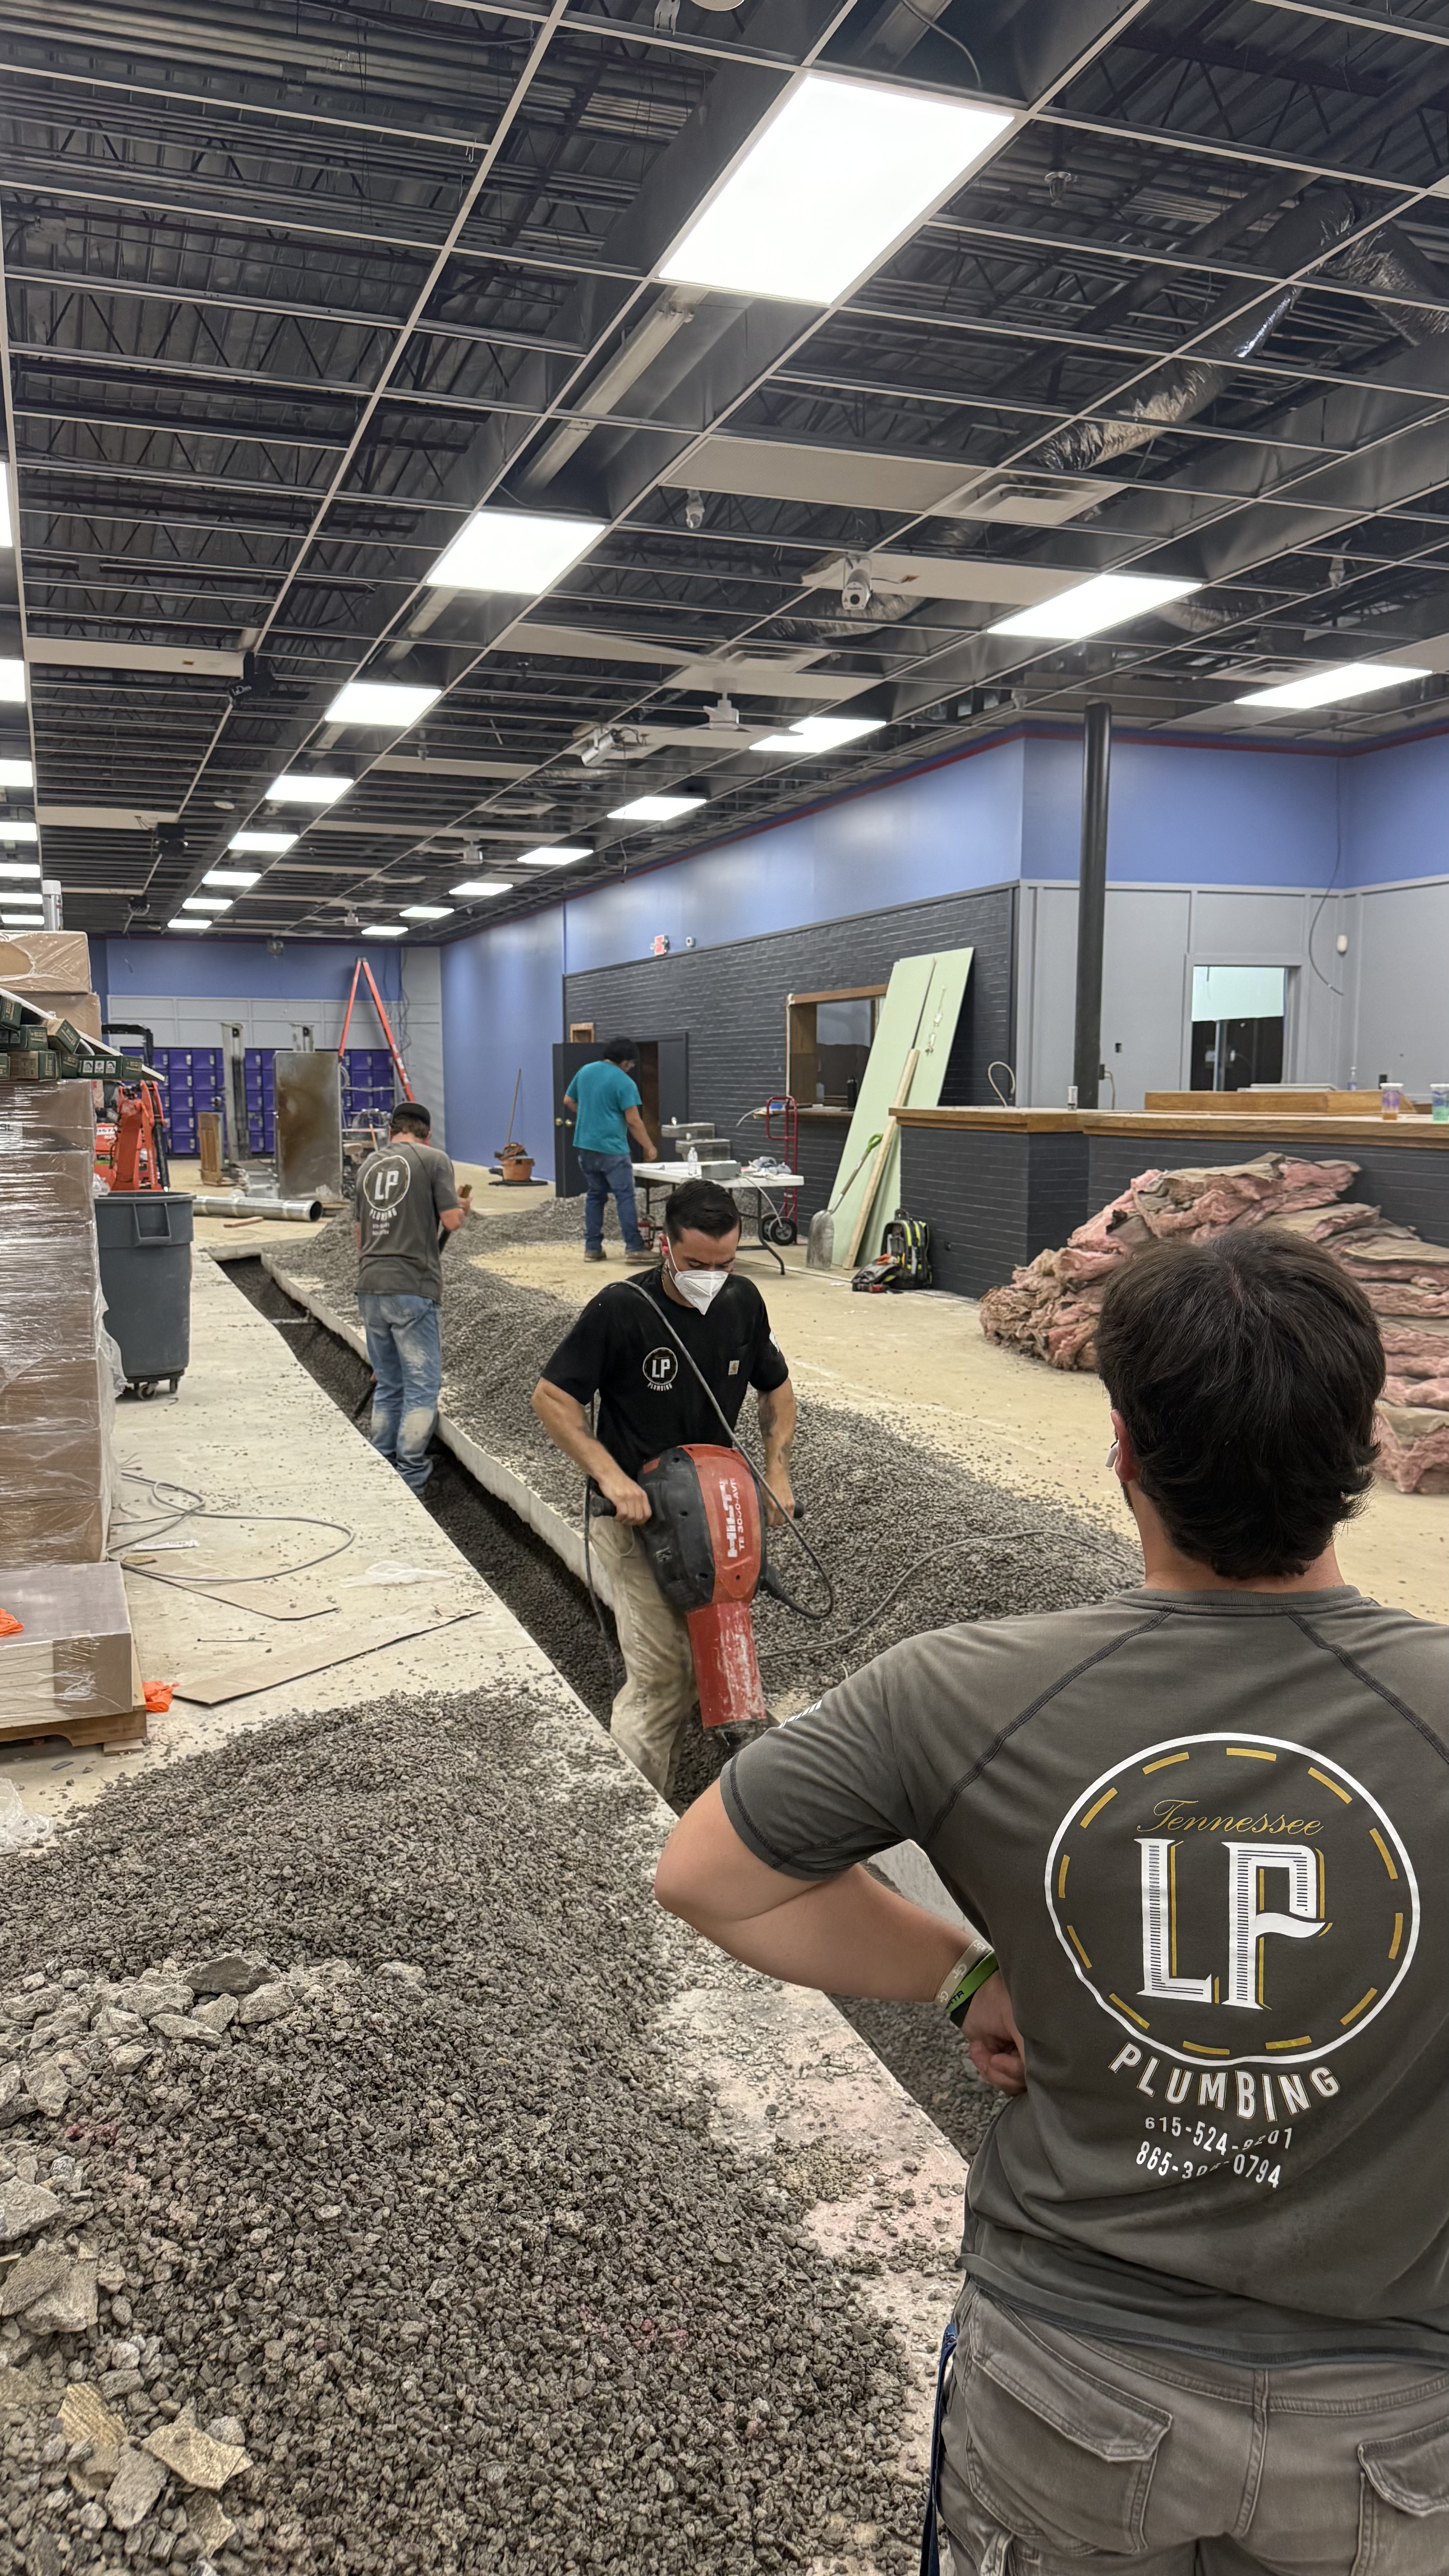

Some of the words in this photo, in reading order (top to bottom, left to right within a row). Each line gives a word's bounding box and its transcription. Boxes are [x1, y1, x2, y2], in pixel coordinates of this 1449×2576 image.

[375, 1170, 399, 1200] LP
[652, 1359, 670, 1378] LP
[1136, 1799, 1324, 1835] Tennessee
[1134, 1838, 1331, 2010] LP
[1108, 2042, 1340, 2122] PLUMBING
